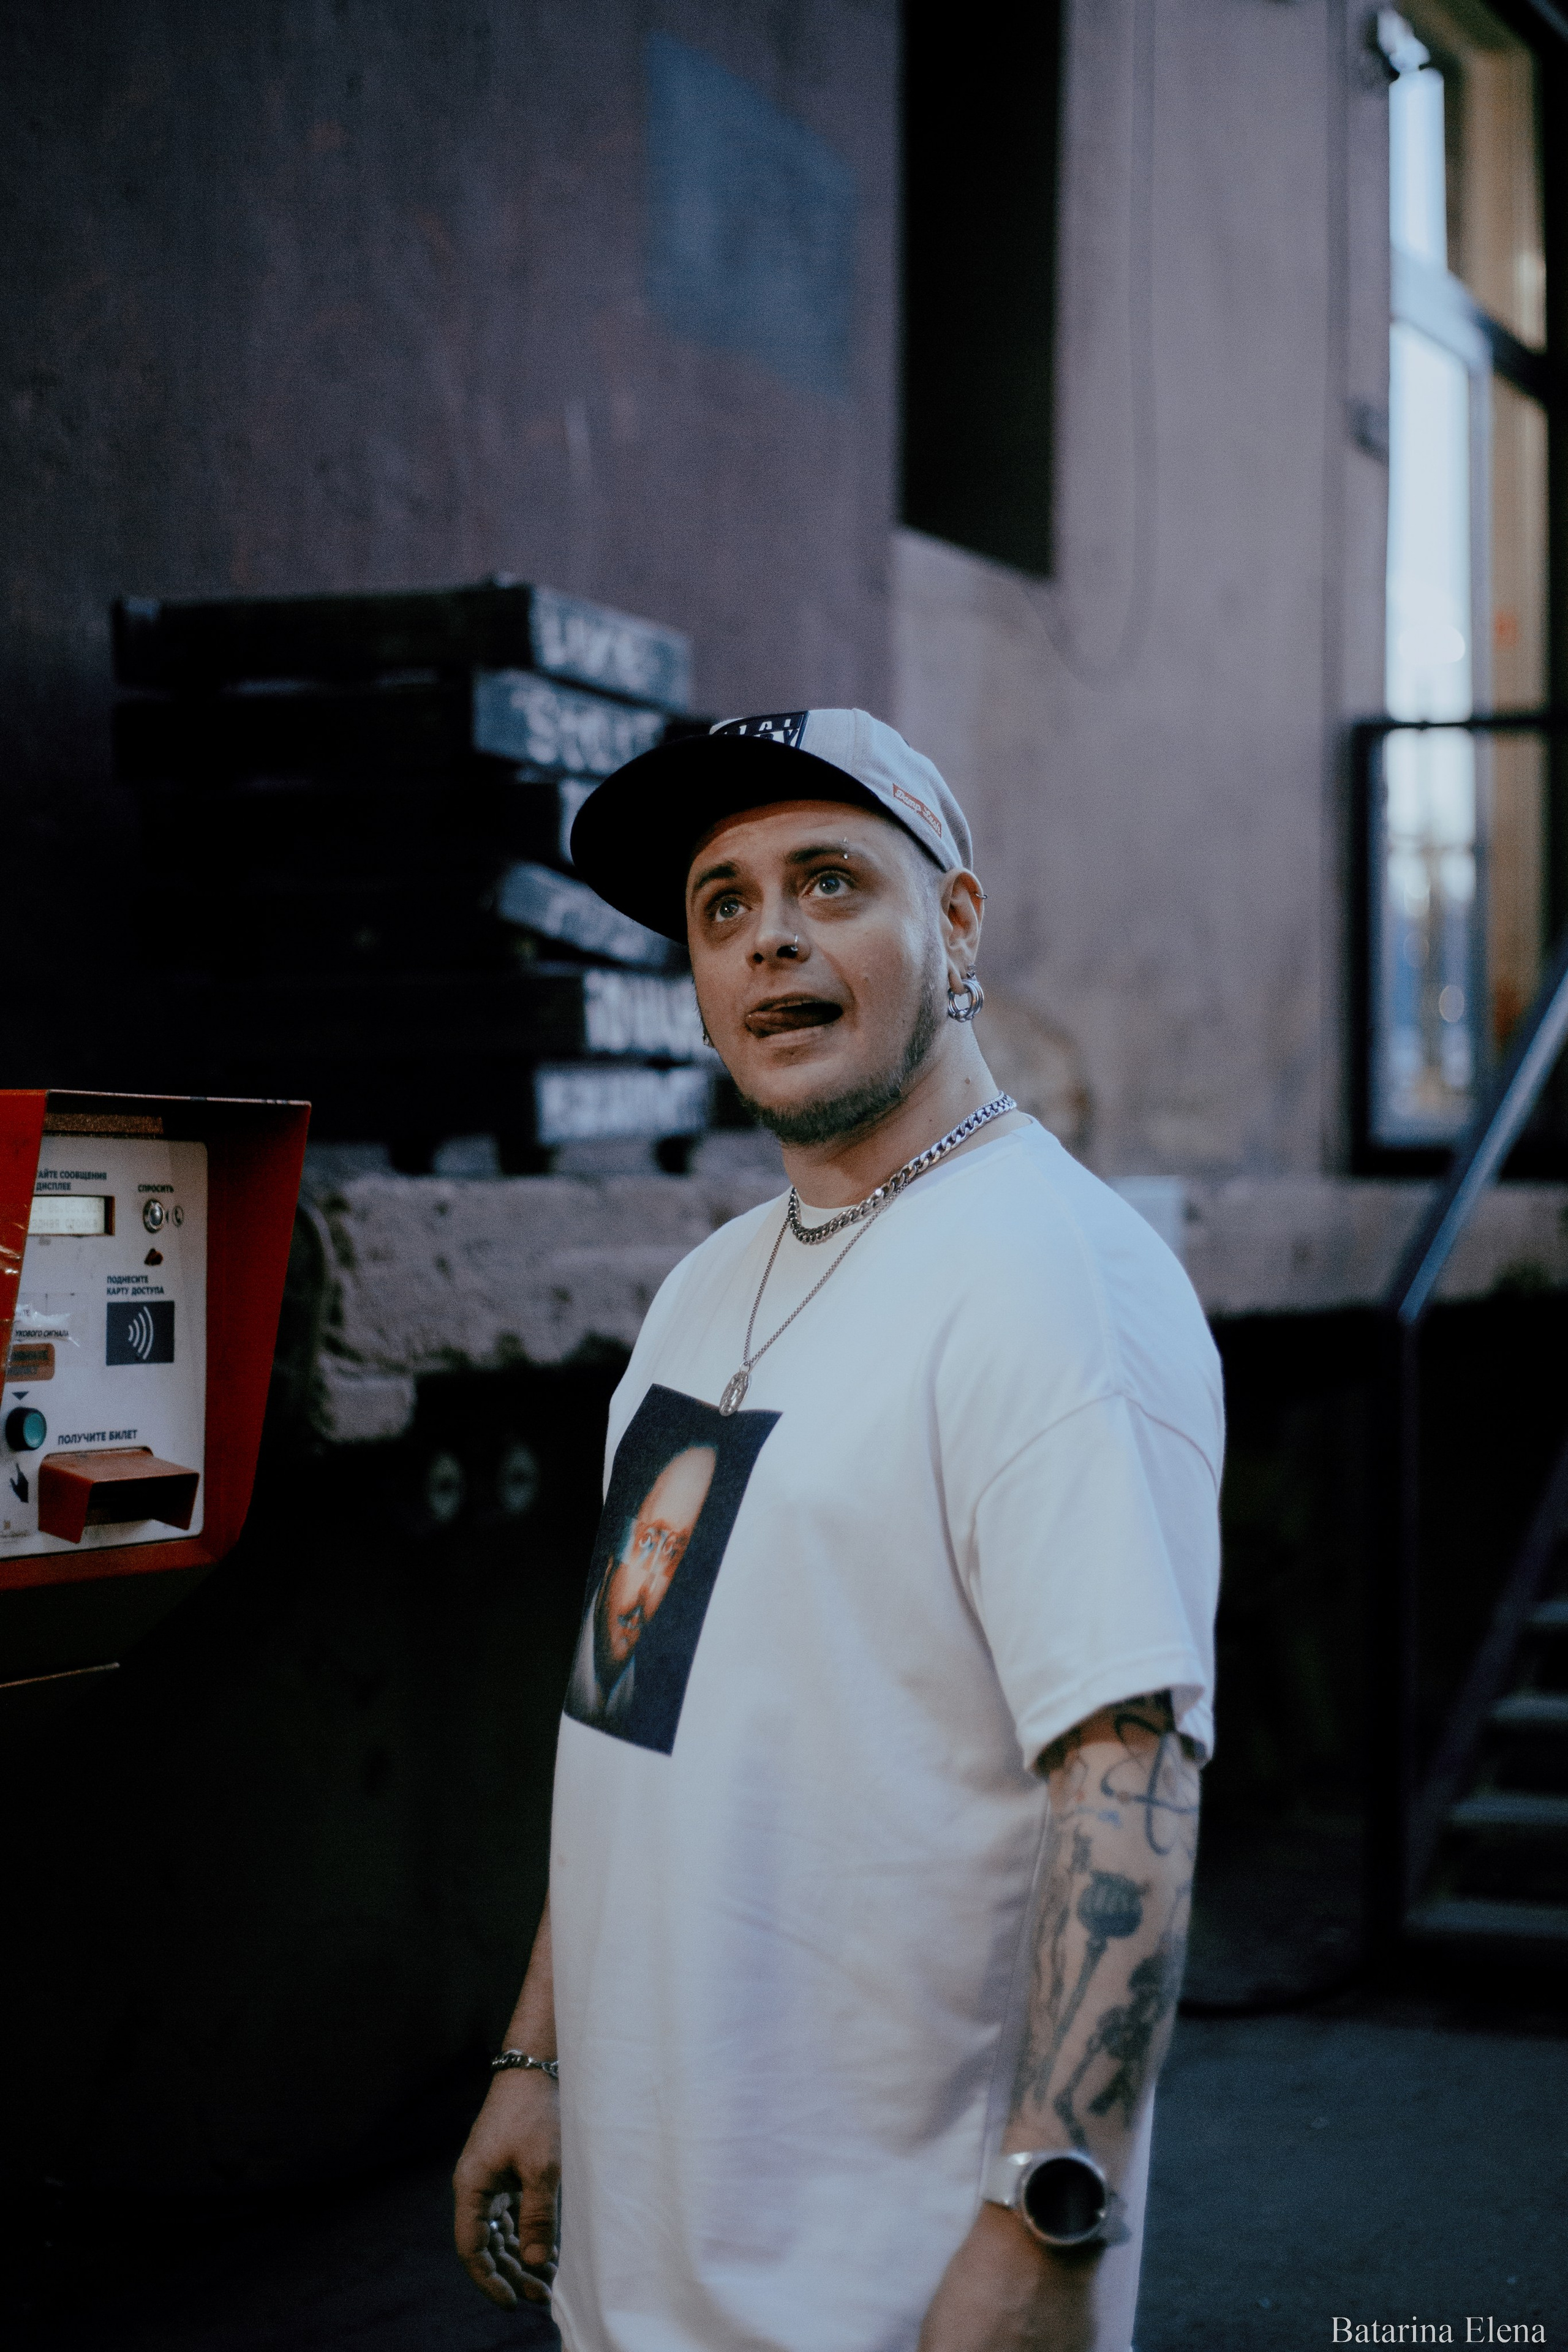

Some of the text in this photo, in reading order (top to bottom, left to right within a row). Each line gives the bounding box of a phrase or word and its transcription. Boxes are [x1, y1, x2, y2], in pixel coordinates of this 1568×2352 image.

[38, 1169, 107, 1180] АЙТЕ СООБЩЕНИЯ
[36, 1182, 71, 1191] ДИСПЛЕЕ
[138, 1184, 174, 1193] СПРОСИТЬ
[107, 1275, 148, 1284] ПОДНЕСИТЕ
[107, 1286, 164, 1295] КАРТУ ДОСТУПА
[58, 1429, 138, 1445] ПОЛУЧИТЕ БИЛЕТ
